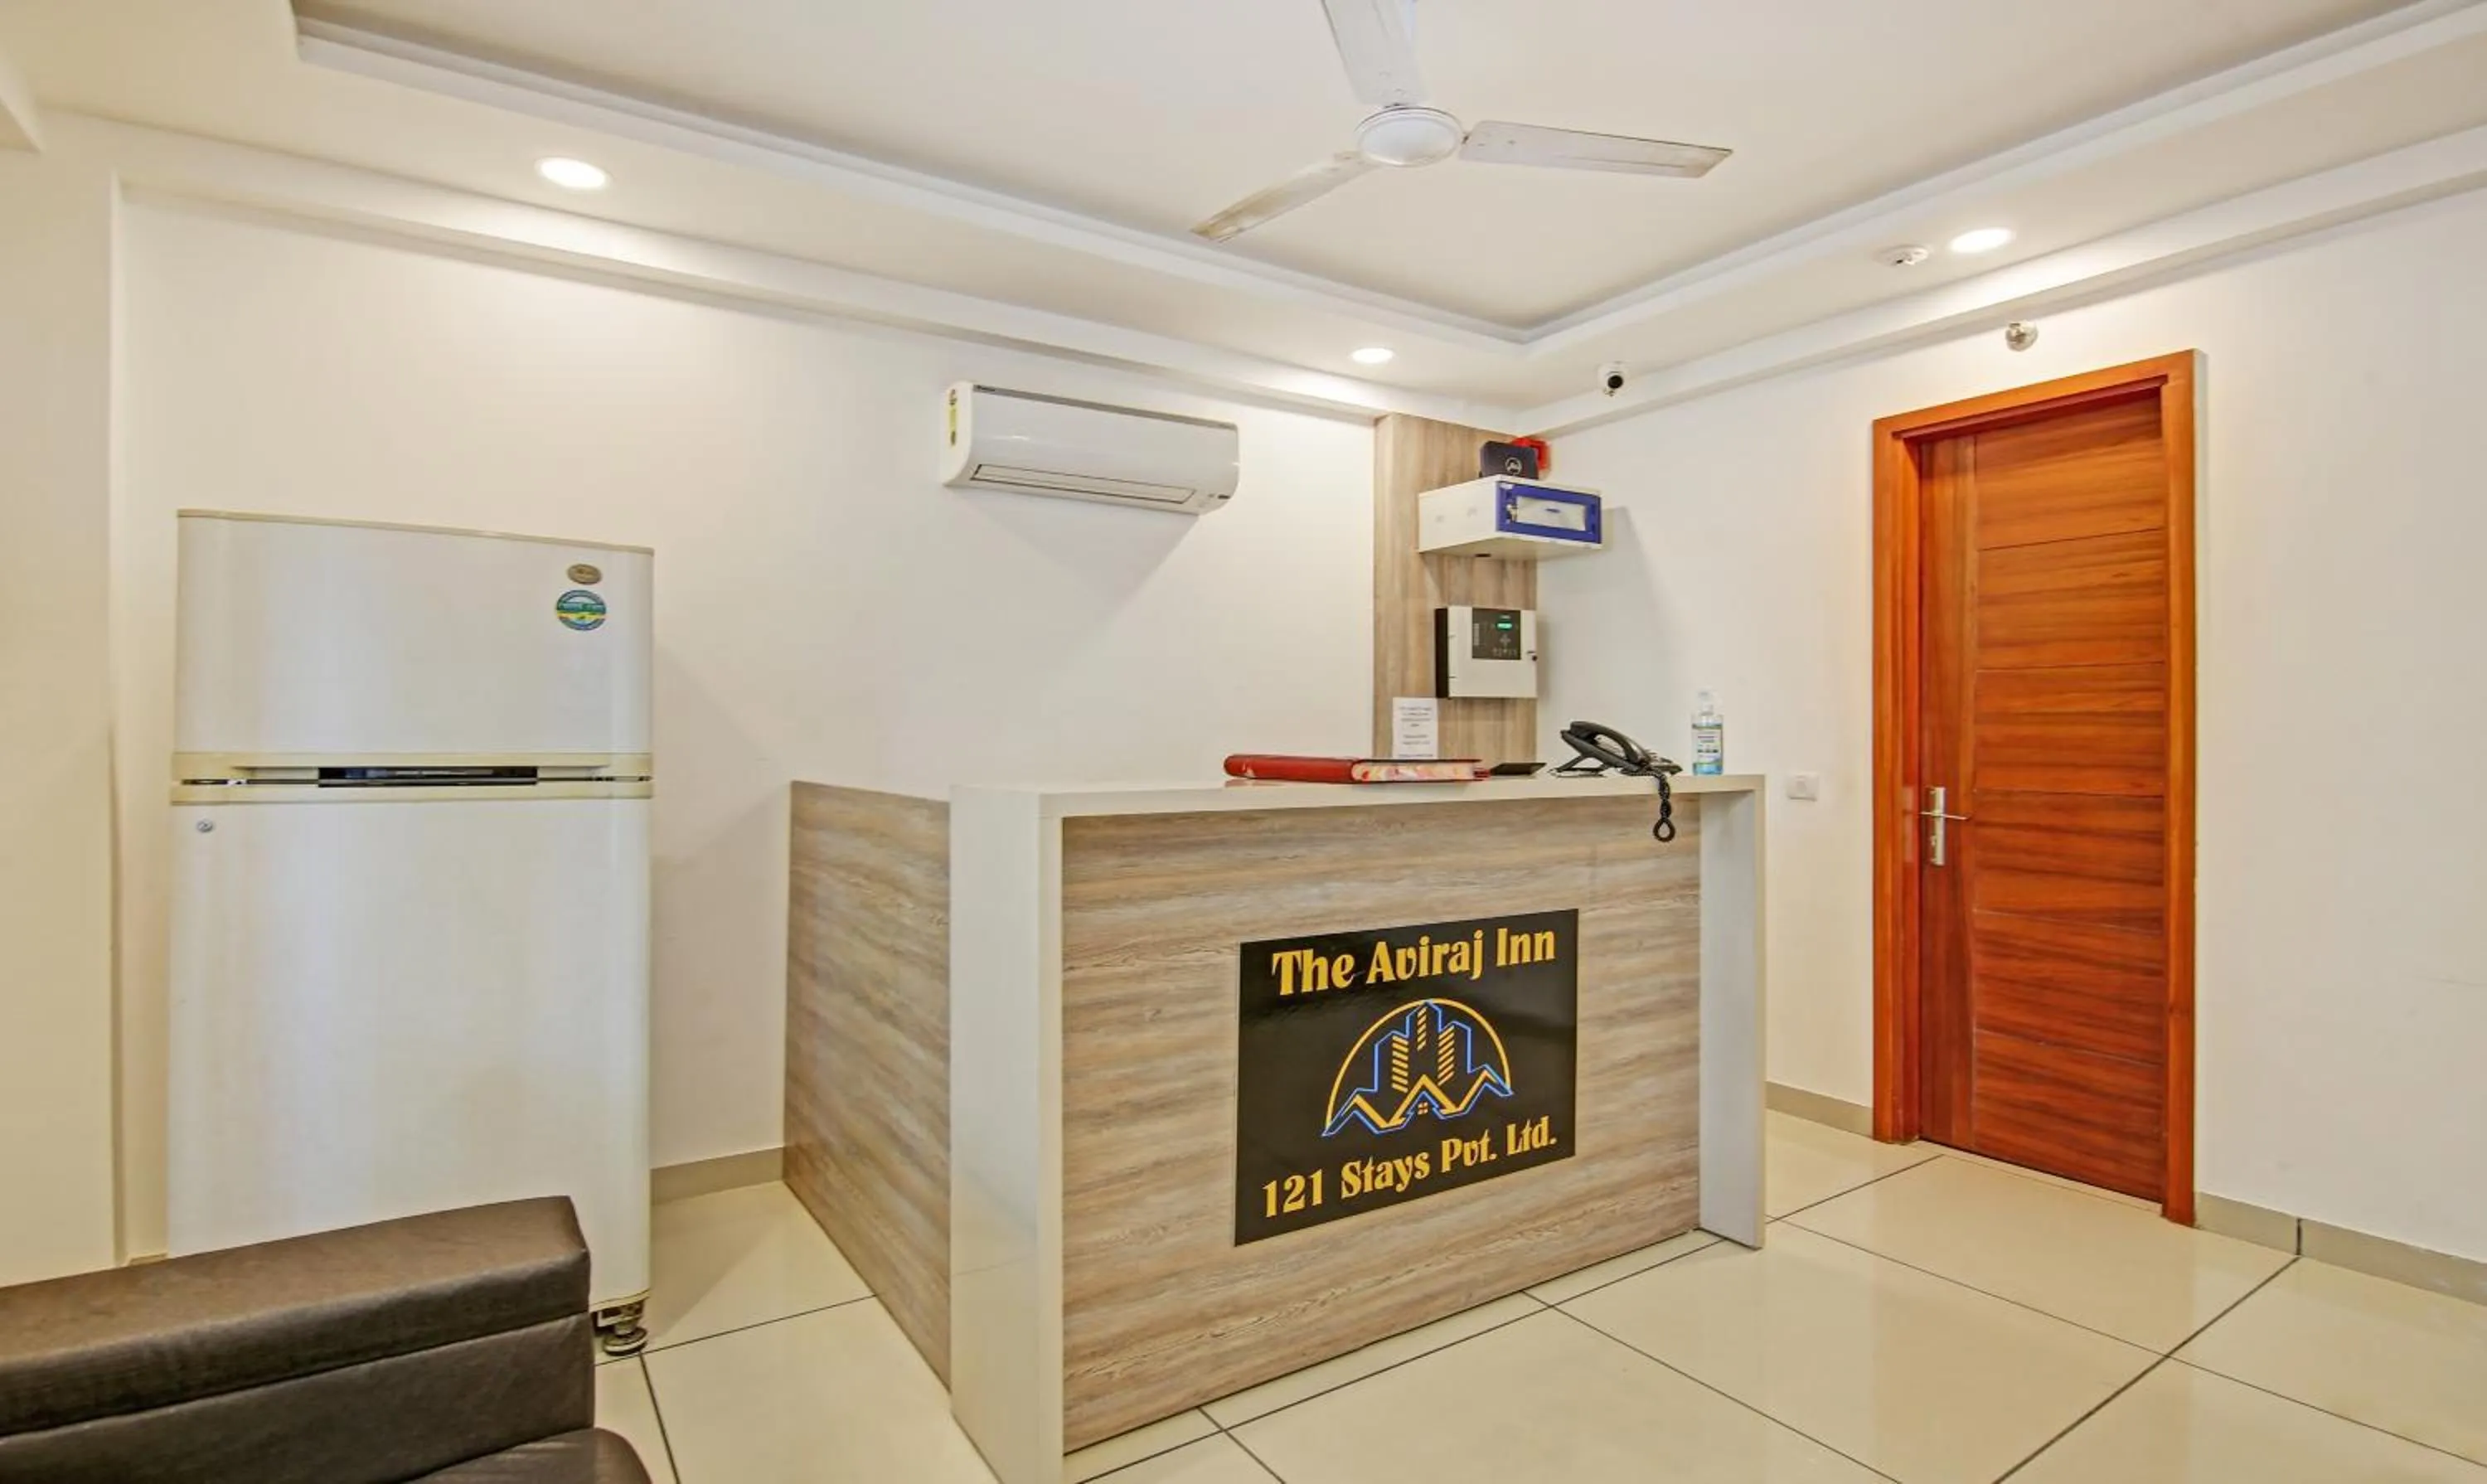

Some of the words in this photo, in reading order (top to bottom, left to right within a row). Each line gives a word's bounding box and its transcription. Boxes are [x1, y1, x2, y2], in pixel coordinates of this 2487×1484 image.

[1272, 948, 1355, 996] The
[1366, 928, 1484, 984] Aviraj
[1496, 928, 1556, 968] Inn
[1263, 1169, 1323, 1218] 121
[1340, 1151, 1430, 1199] Stays
[1441, 1129, 1497, 1173] Pvt.
[1506, 1115, 1557, 1156] Ltd.
